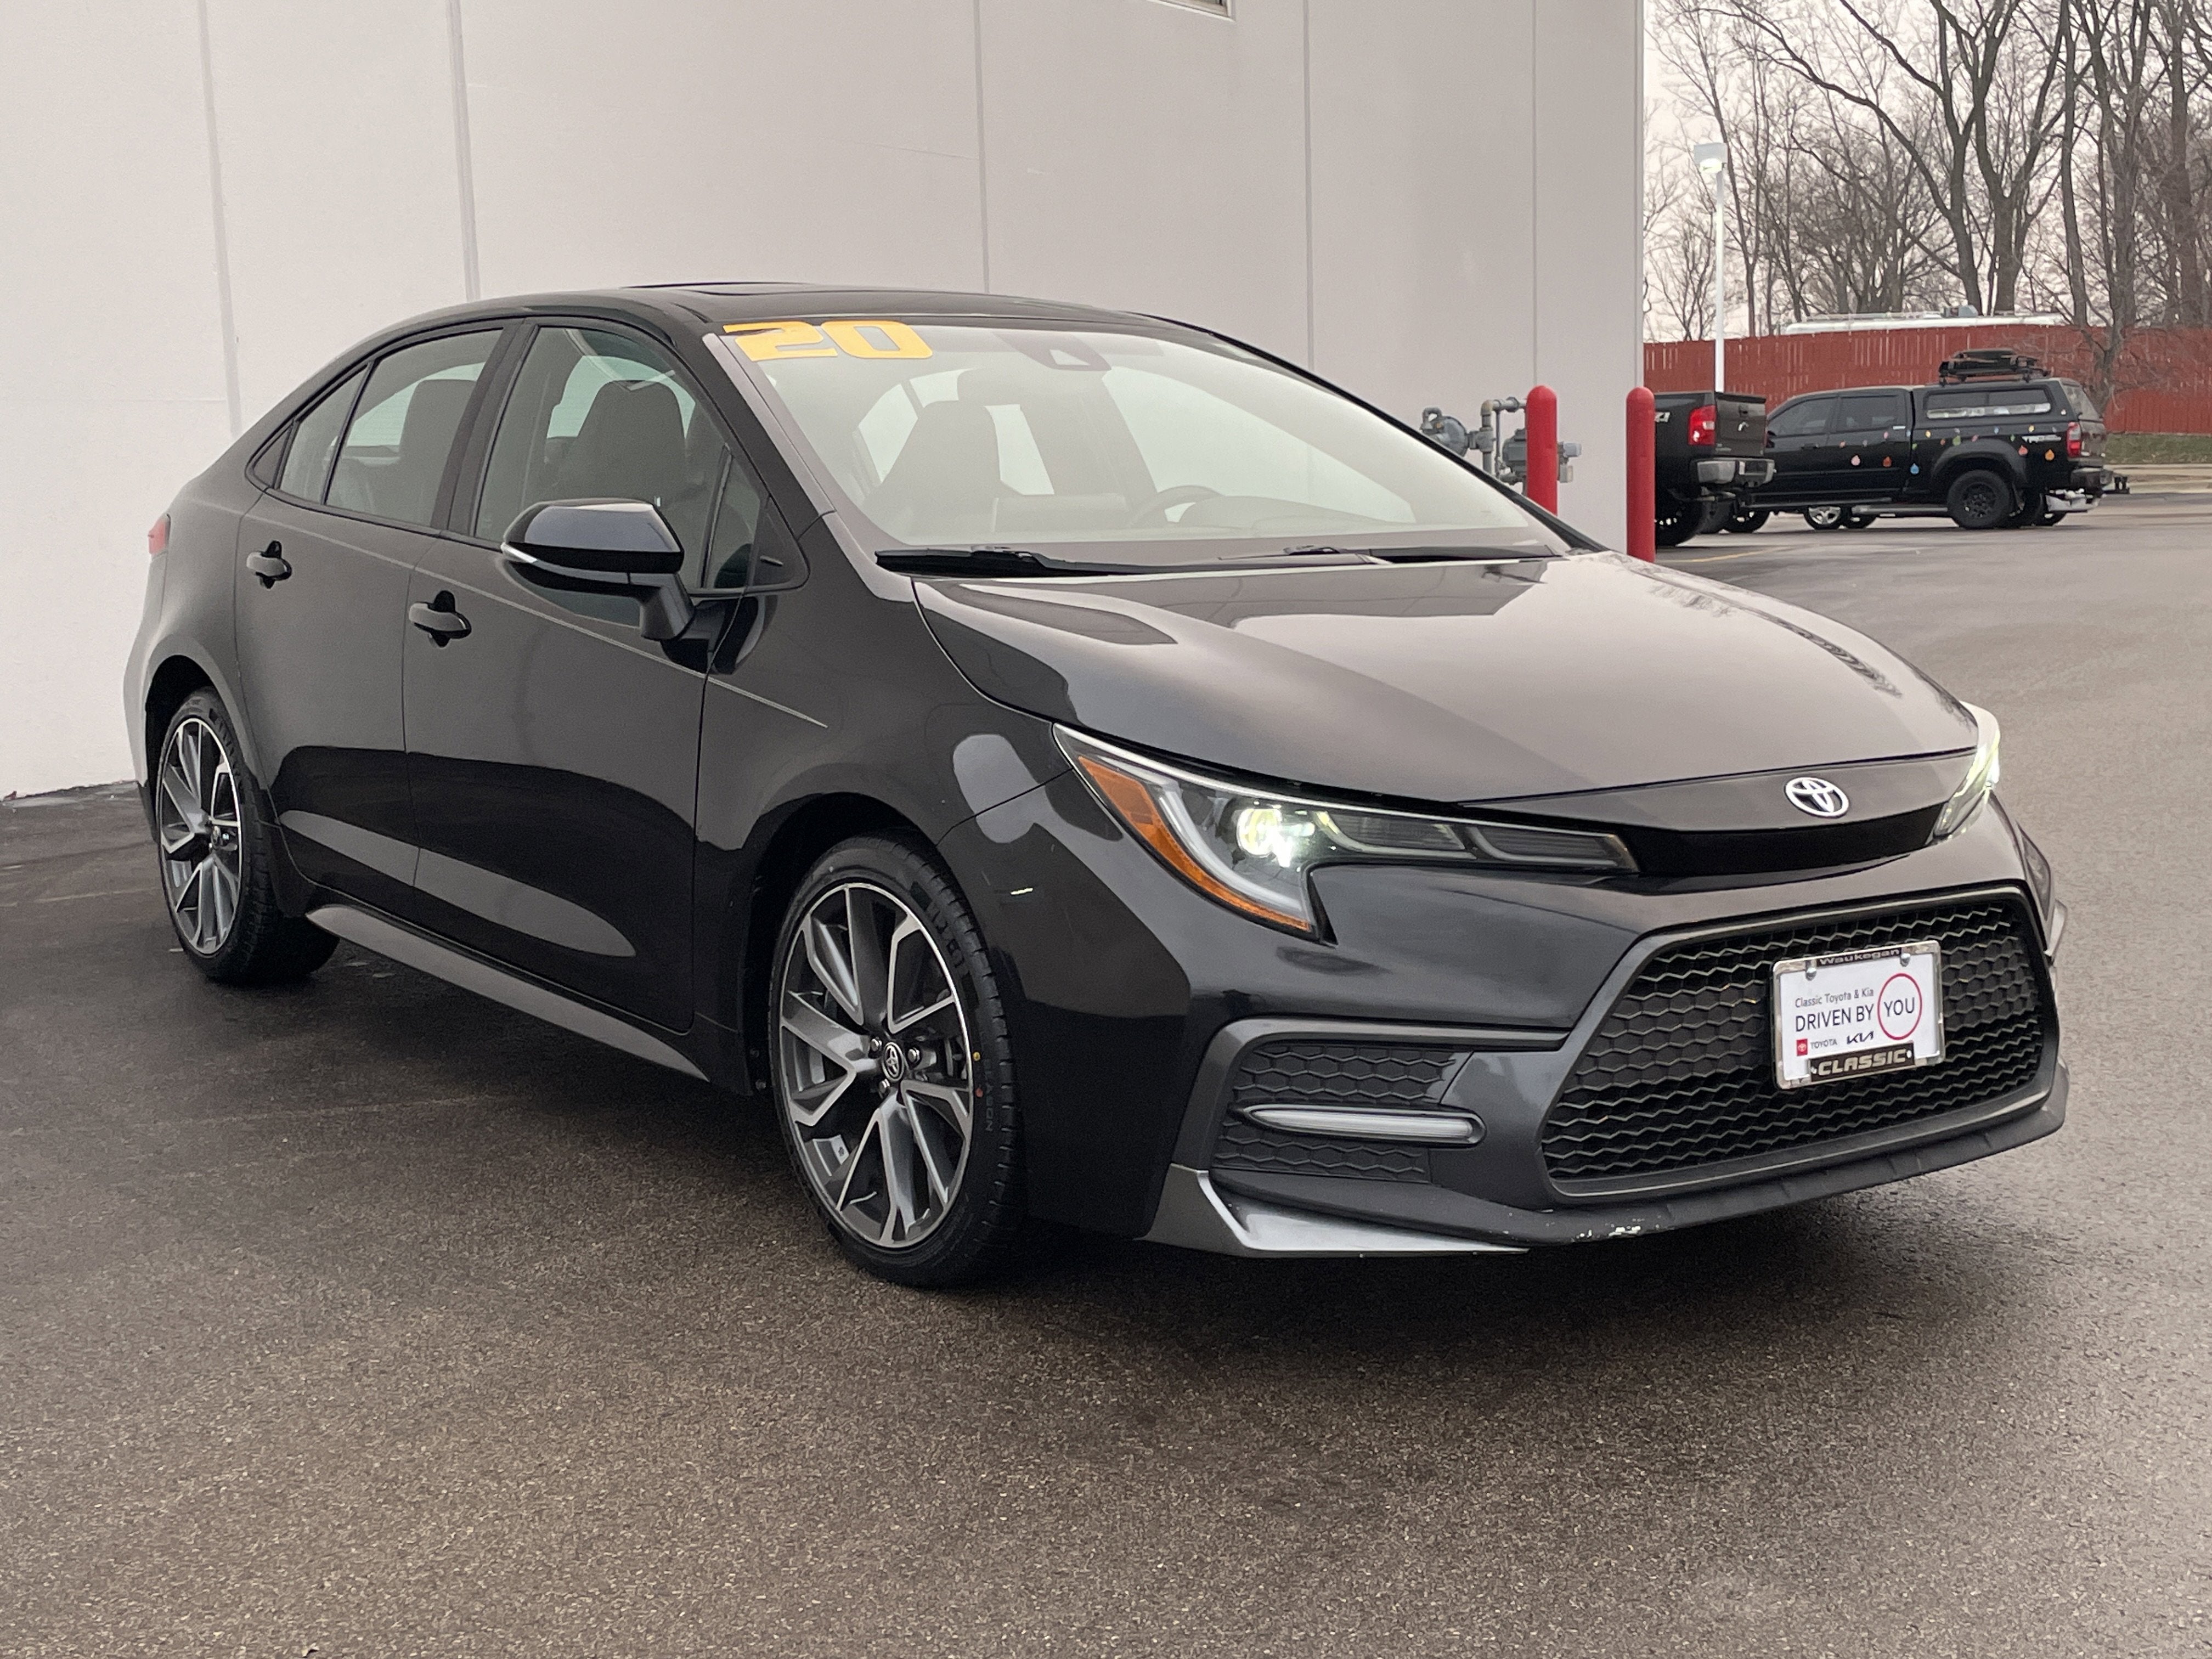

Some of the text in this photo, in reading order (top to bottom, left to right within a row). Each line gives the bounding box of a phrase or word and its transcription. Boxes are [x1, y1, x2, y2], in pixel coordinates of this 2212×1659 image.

[723, 320, 933, 362] 20
[1819, 949, 1900, 965] Waukegan
[1795, 987, 1874, 1008] Classic Toyota & Kia
[1796, 997, 1915, 1032] DRIVEN BY YOU
[1810, 1039, 1837, 1049] TOYOTA
[1818, 1049, 1907, 1076] CLASSIC
